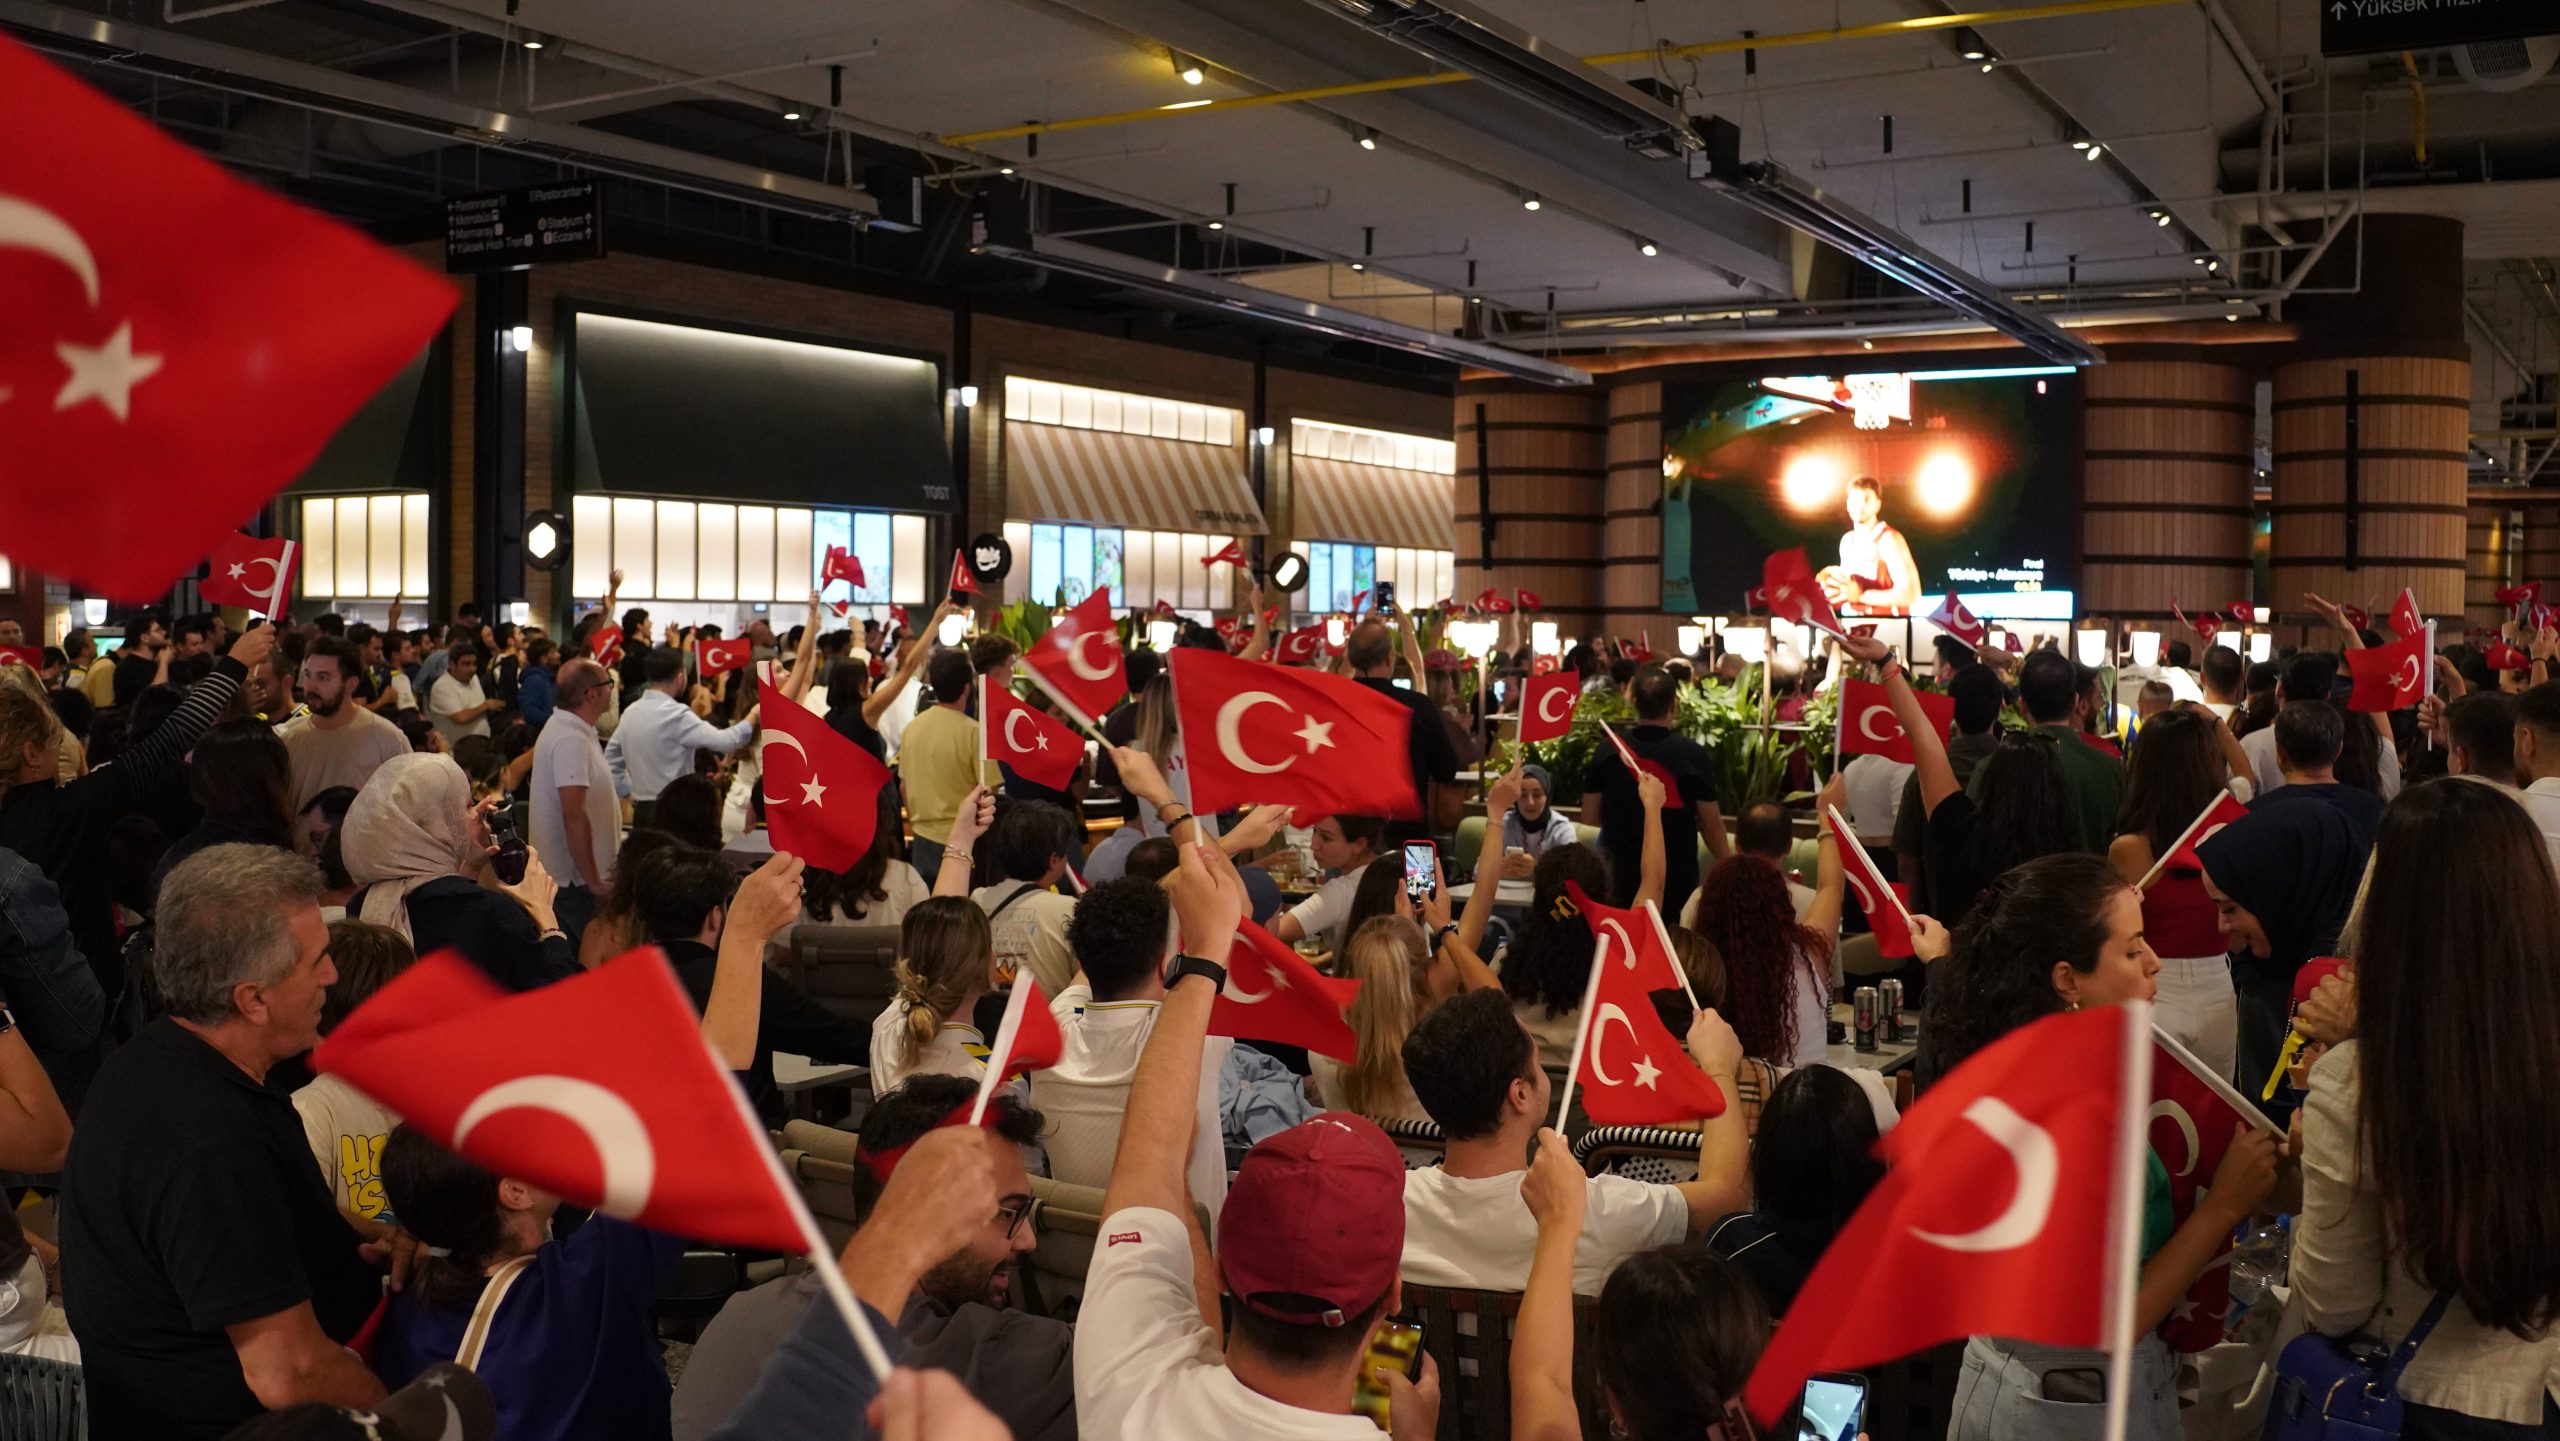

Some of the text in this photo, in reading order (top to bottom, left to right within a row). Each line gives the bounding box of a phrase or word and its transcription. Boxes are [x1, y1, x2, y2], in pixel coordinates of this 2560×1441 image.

[2353, 0, 2429, 17] Yüksek
[547, 216, 584, 231] Stadyum
[552, 231, 584, 244] Eczane
[922, 485, 950, 500] TOST
